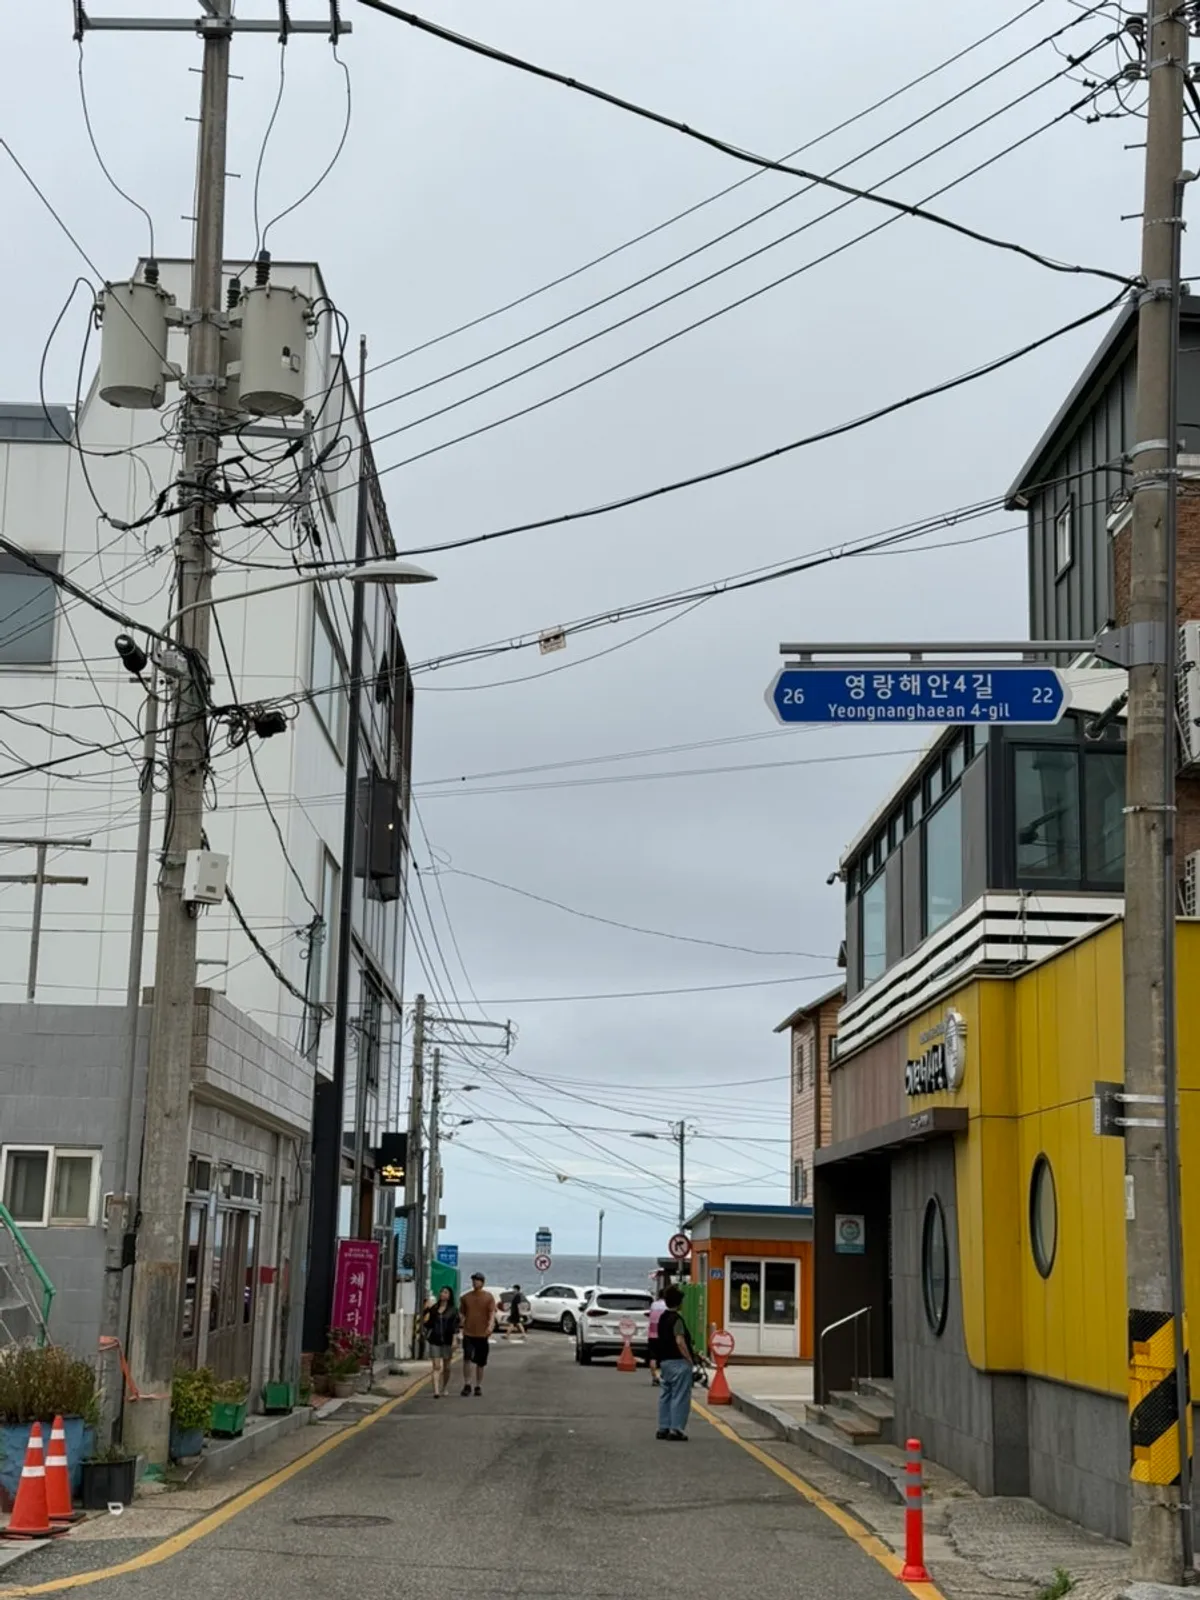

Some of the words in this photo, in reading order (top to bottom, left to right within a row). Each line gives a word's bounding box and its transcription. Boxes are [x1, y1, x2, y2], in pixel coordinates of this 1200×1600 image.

[846, 674, 993, 699] 영랑해안4길
[783, 688, 805, 704] 26
[1031, 687, 1054, 704] 22
[827, 703, 966, 721] Yeongnanghaean
[970, 703, 1011, 721] 4-gil
